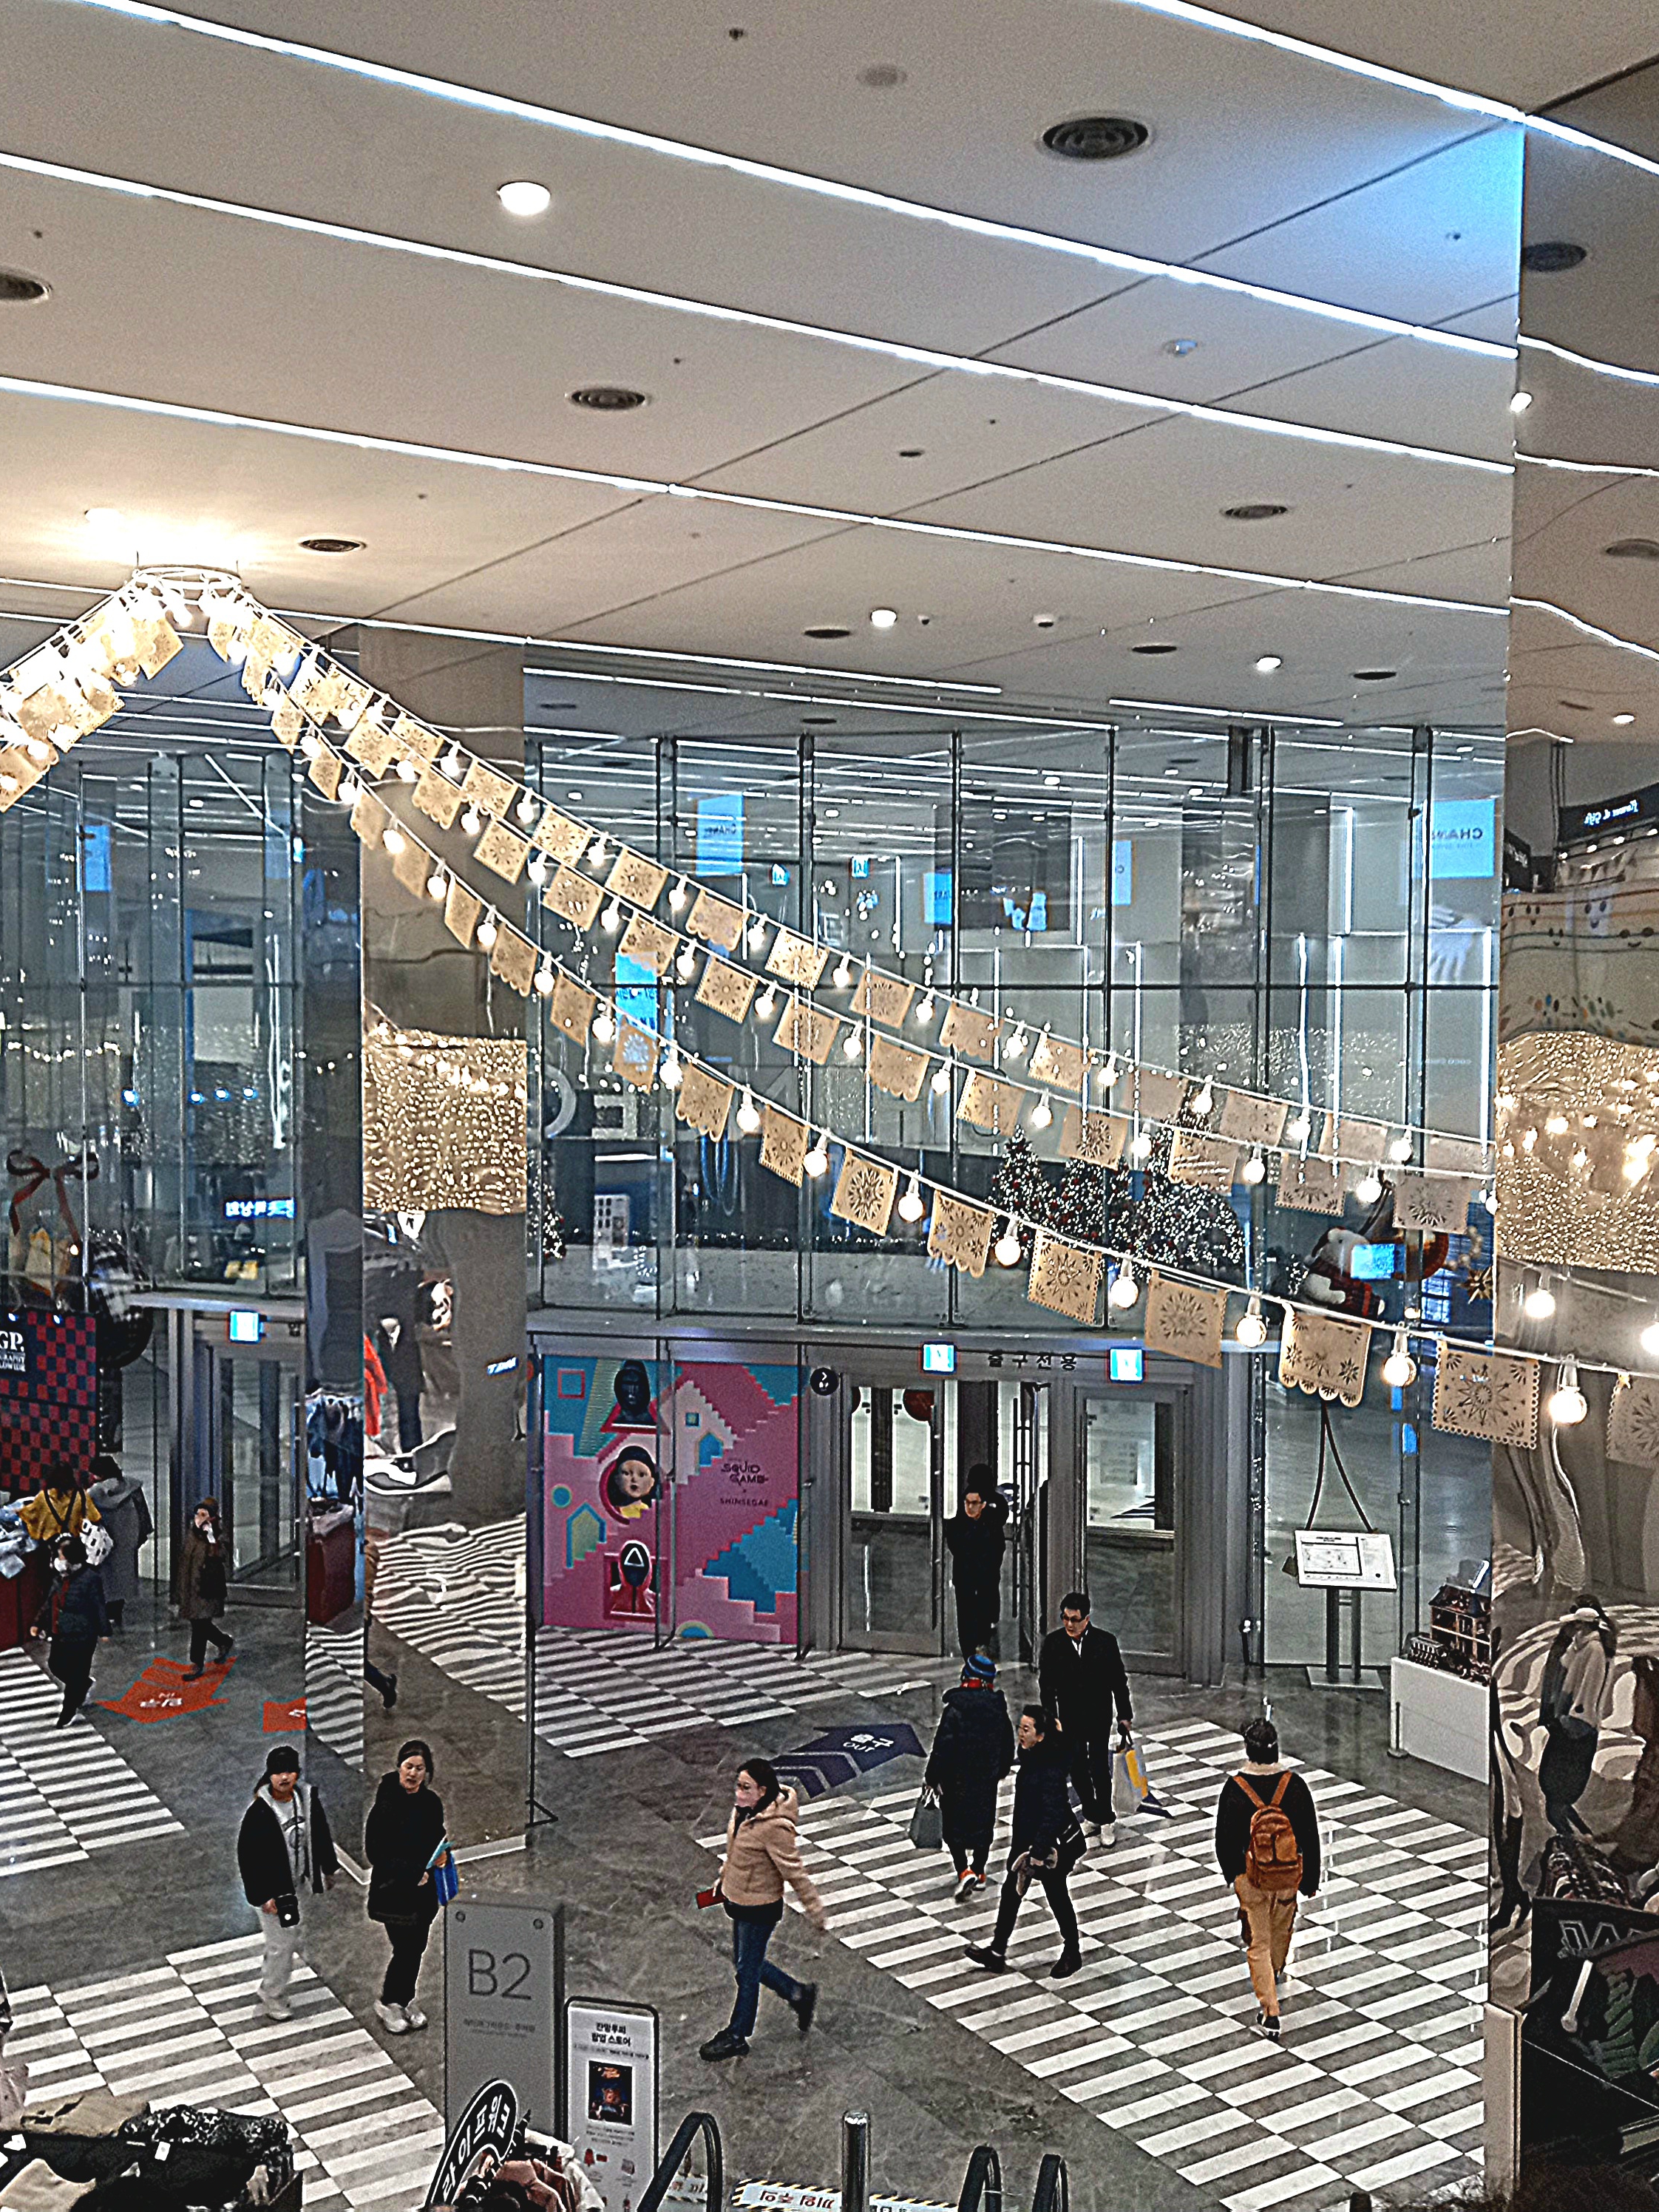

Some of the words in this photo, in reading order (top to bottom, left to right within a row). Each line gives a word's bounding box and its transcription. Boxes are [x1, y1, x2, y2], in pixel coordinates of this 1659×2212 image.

[721, 1461, 761, 1474] SQUID
[730, 1473, 769, 1486] GAME
[720, 1498, 768, 1507] SHINSEGAE
[843, 1742, 875, 1752] OUT
[469, 1949, 532, 2000] B2
[608, 2035, 631, 2047] 스토어
[442, 2094, 510, 2202] 라이프워크
